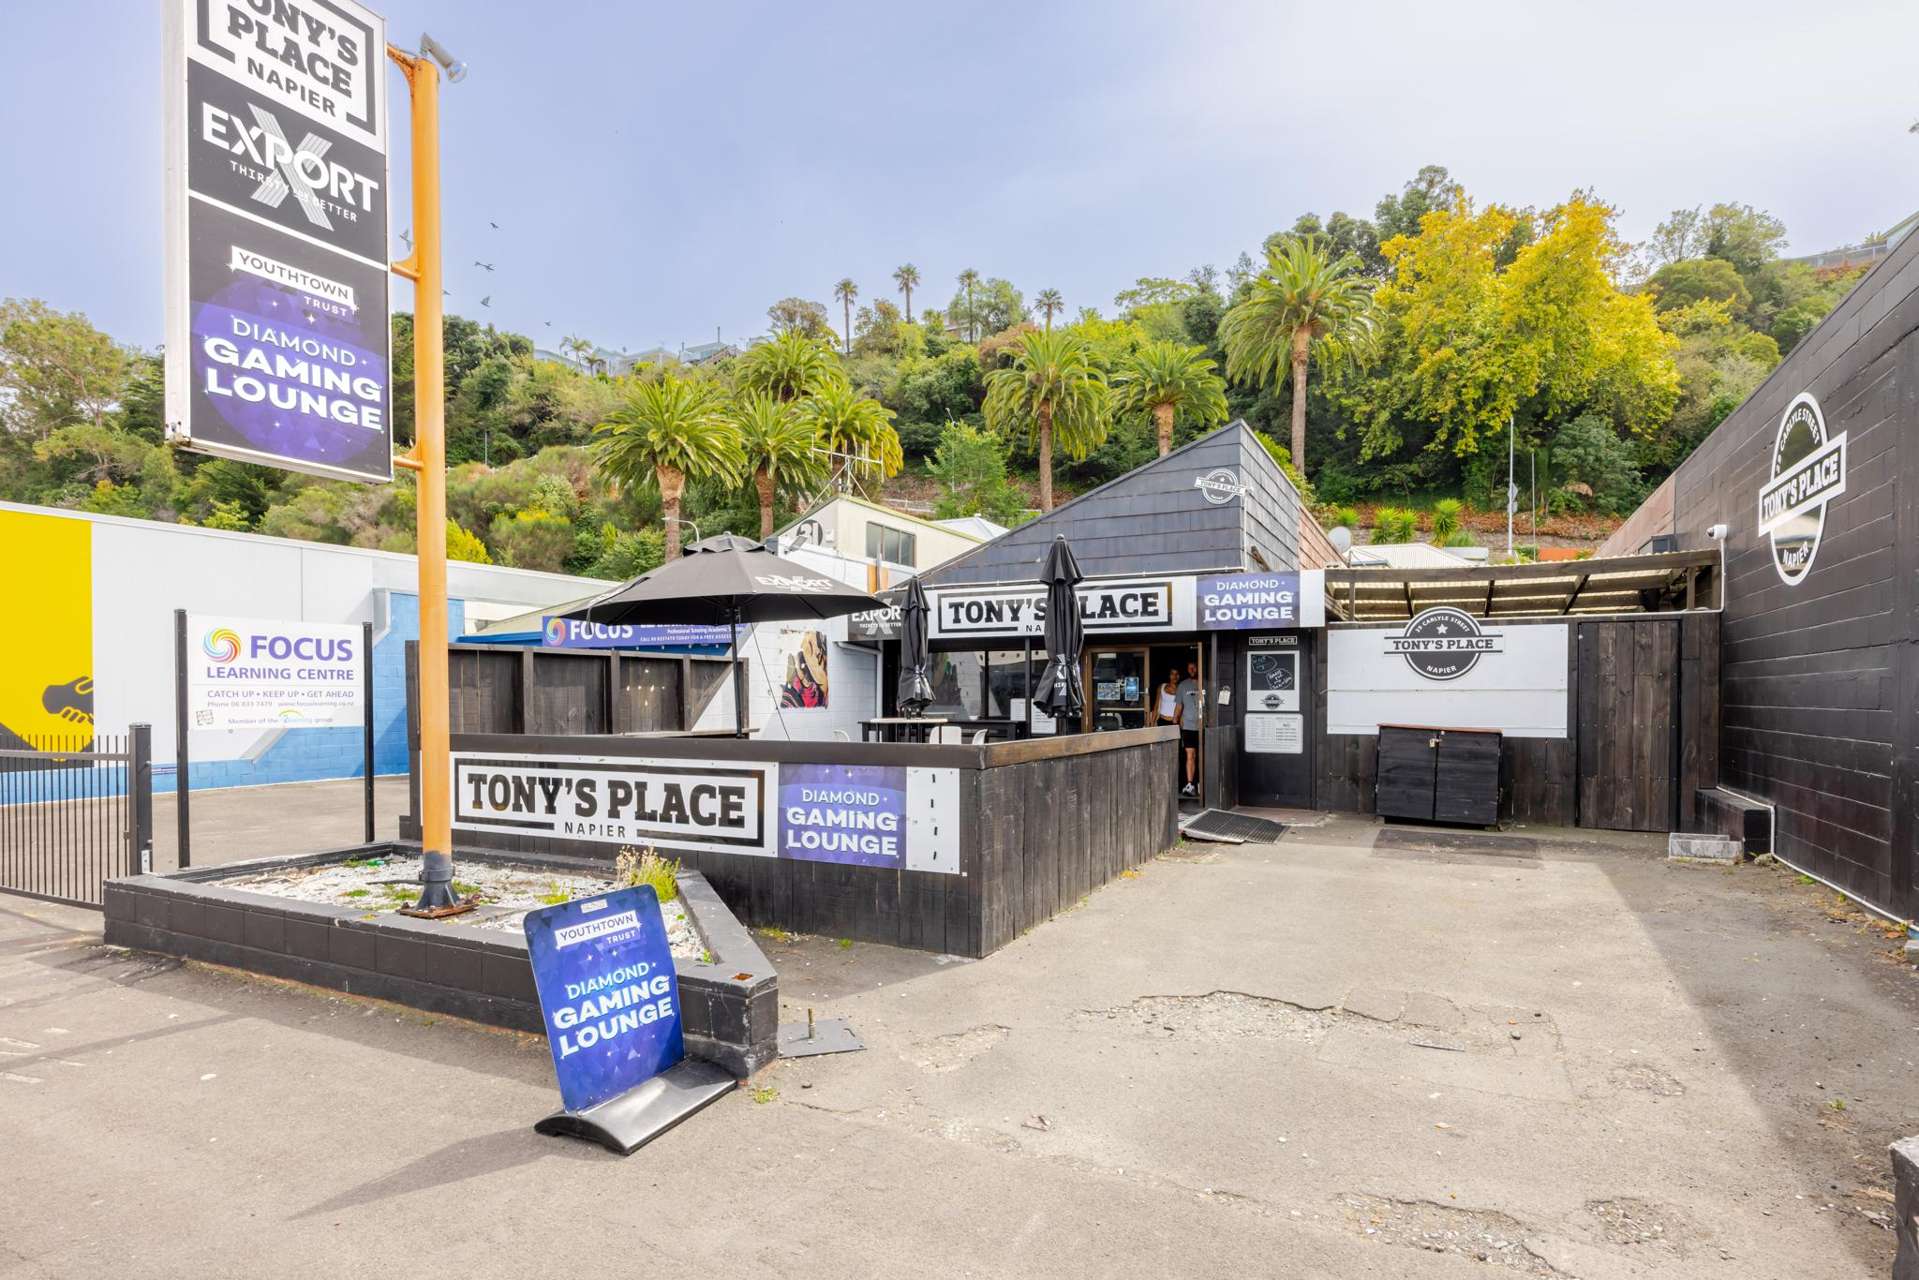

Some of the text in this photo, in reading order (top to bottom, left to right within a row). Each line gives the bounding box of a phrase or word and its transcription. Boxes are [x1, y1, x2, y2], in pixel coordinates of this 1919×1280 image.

[247, 0, 358, 66] ONY'S
[227, 4, 352, 99] PLACE
[247, 57, 336, 117] NAPIER
[202, 102, 379, 213] EXPORT
[239, 252, 349, 299] YOUTHTOWN
[304, 296, 347, 316] TRUST
[233, 318, 355, 367] DIAMOND
[204, 337, 381, 402] GAMING
[206, 368, 382, 430] LOUNGE
[1780, 408, 1802, 451] CARLYLE
[1802, 408, 1820, 444] STREET
[1763, 453, 1839, 520] TONY'S PLACE
[1783, 541, 1808, 566] NAPIER
[1216, 579, 1279, 591] DIAMOND
[948, 592, 1159, 624] TONY'S LACE
[1204, 591, 1293, 606] GAMING
[851, 605, 901, 621] EXPOR
[1205, 606, 1293, 621] LOUNGE
[1422, 616, 1449, 626] CARLYLE
[1450, 617, 1471, 632] STREET
[570, 620, 634, 640] FOCUS
[251, 635, 353, 662] FOCUS
[1393, 639, 1493, 650] TONY'S PLACE
[207, 666, 354, 680] LEARNING CENTRE
[1426, 665, 1457, 673] NAPIER
[207, 690, 354, 698] CATCH UP KEEP UP GET AHEAD
[467, 773, 745, 828] TONY'S PLACE
[802, 789, 879, 806] DIAMOND
[565, 821, 625, 838] NAPIER
[786, 807, 897, 831] GAMING
[787, 829, 897, 856] LOUNGE
[560, 915, 634, 941] YOUTHTOWN
[606, 931, 636, 945] TRUST
[567, 962, 649, 1000] DIAMOND
[554, 976, 670, 1029] GAMING
[559, 997, 673, 1057] LOUNGE
